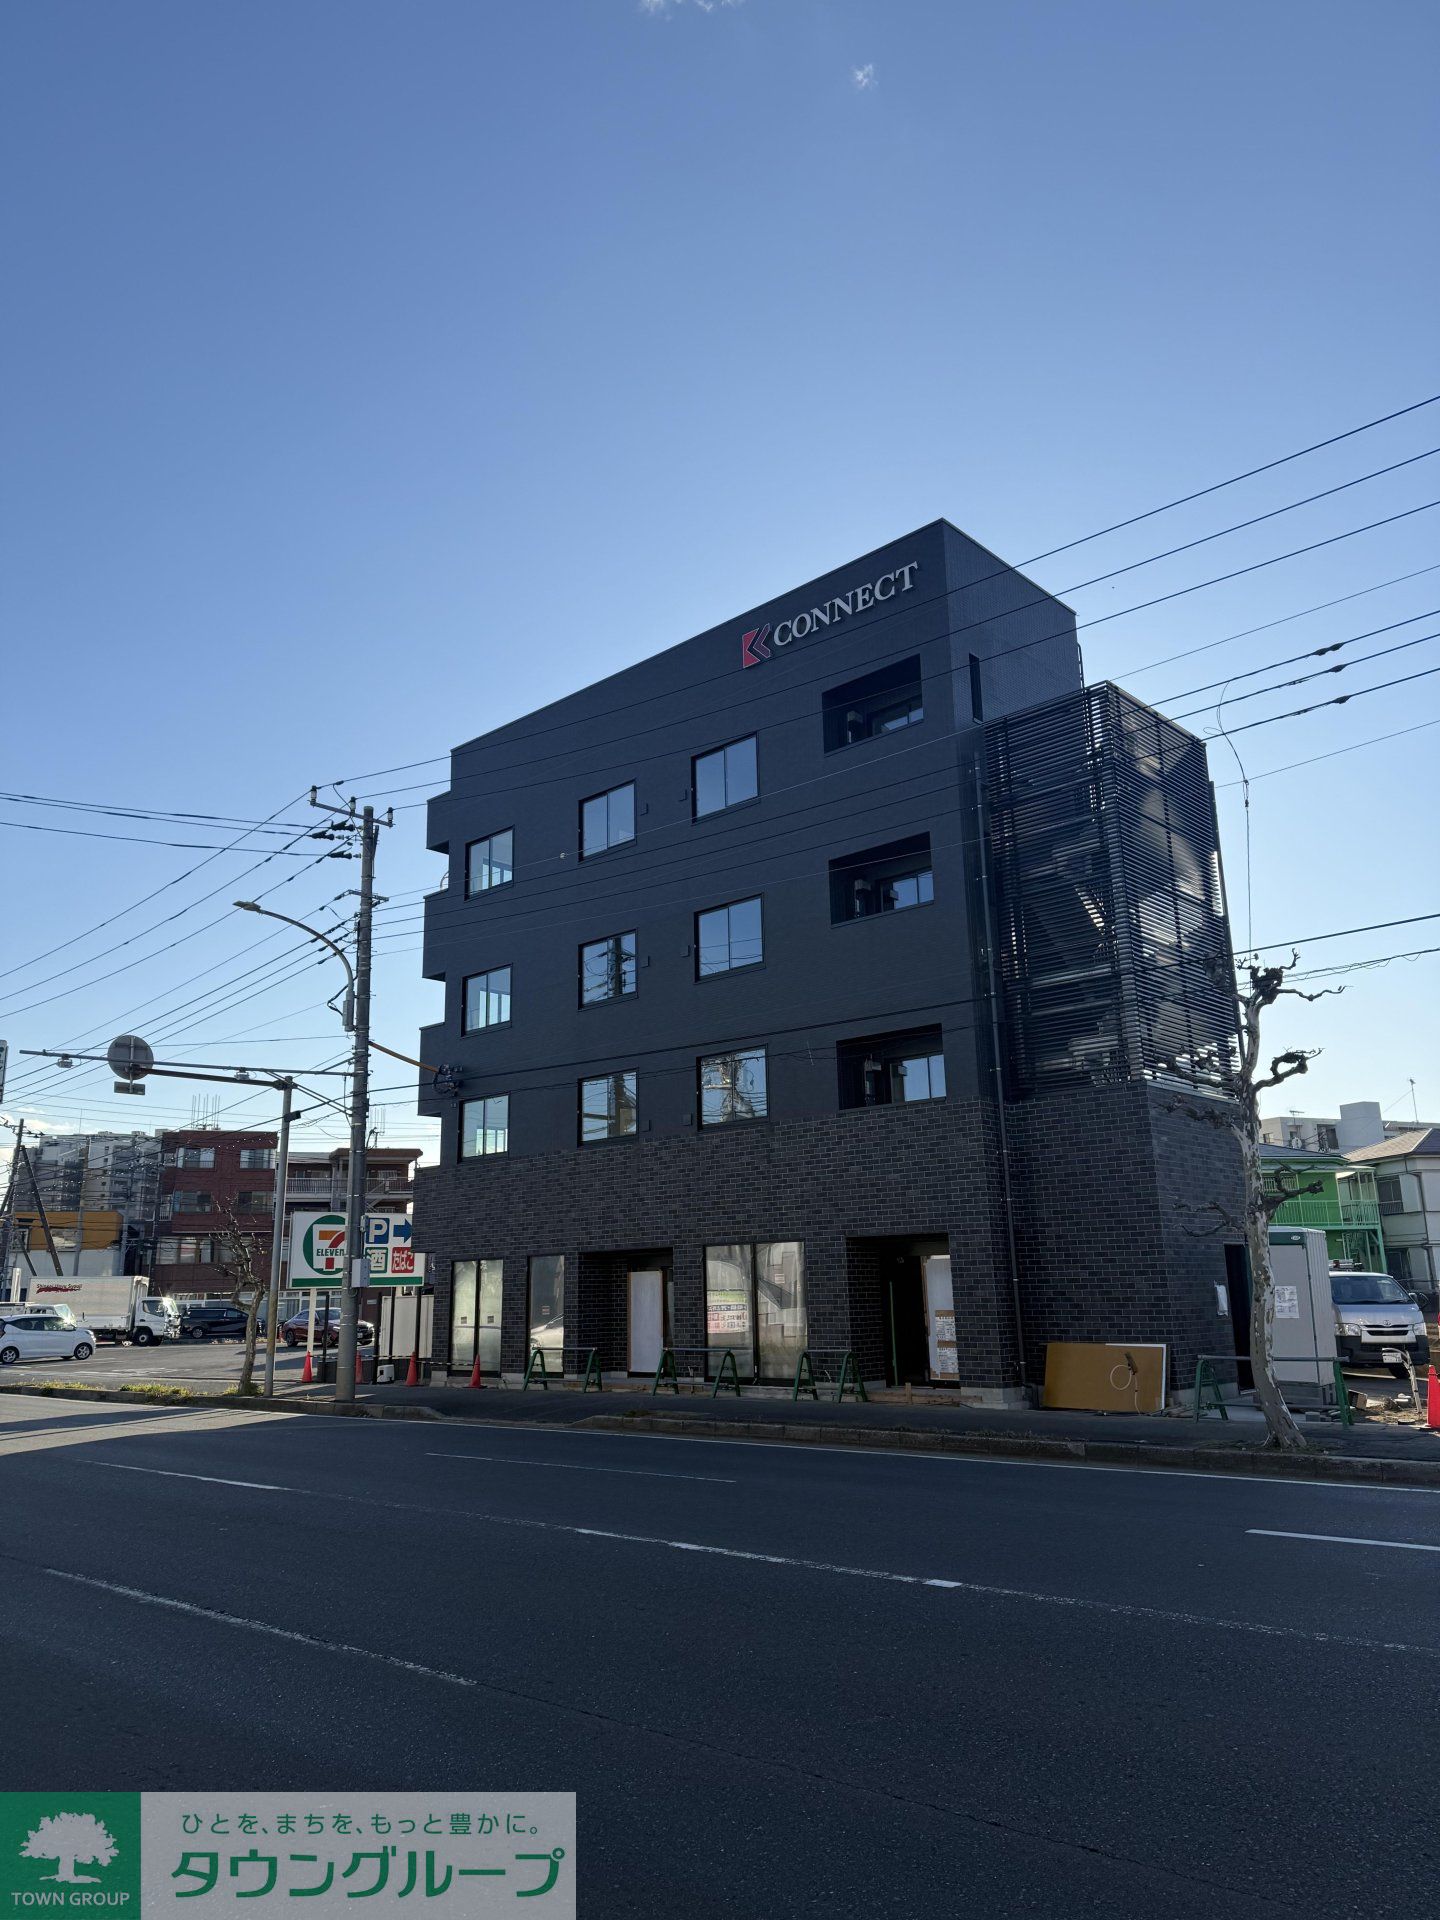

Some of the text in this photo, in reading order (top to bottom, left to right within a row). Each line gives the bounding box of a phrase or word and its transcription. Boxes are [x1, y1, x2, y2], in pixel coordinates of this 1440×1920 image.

[773, 561, 919, 646] CONNECT
[368, 1219, 388, 1243] P
[391, 1249, 414, 1271] たばこ
